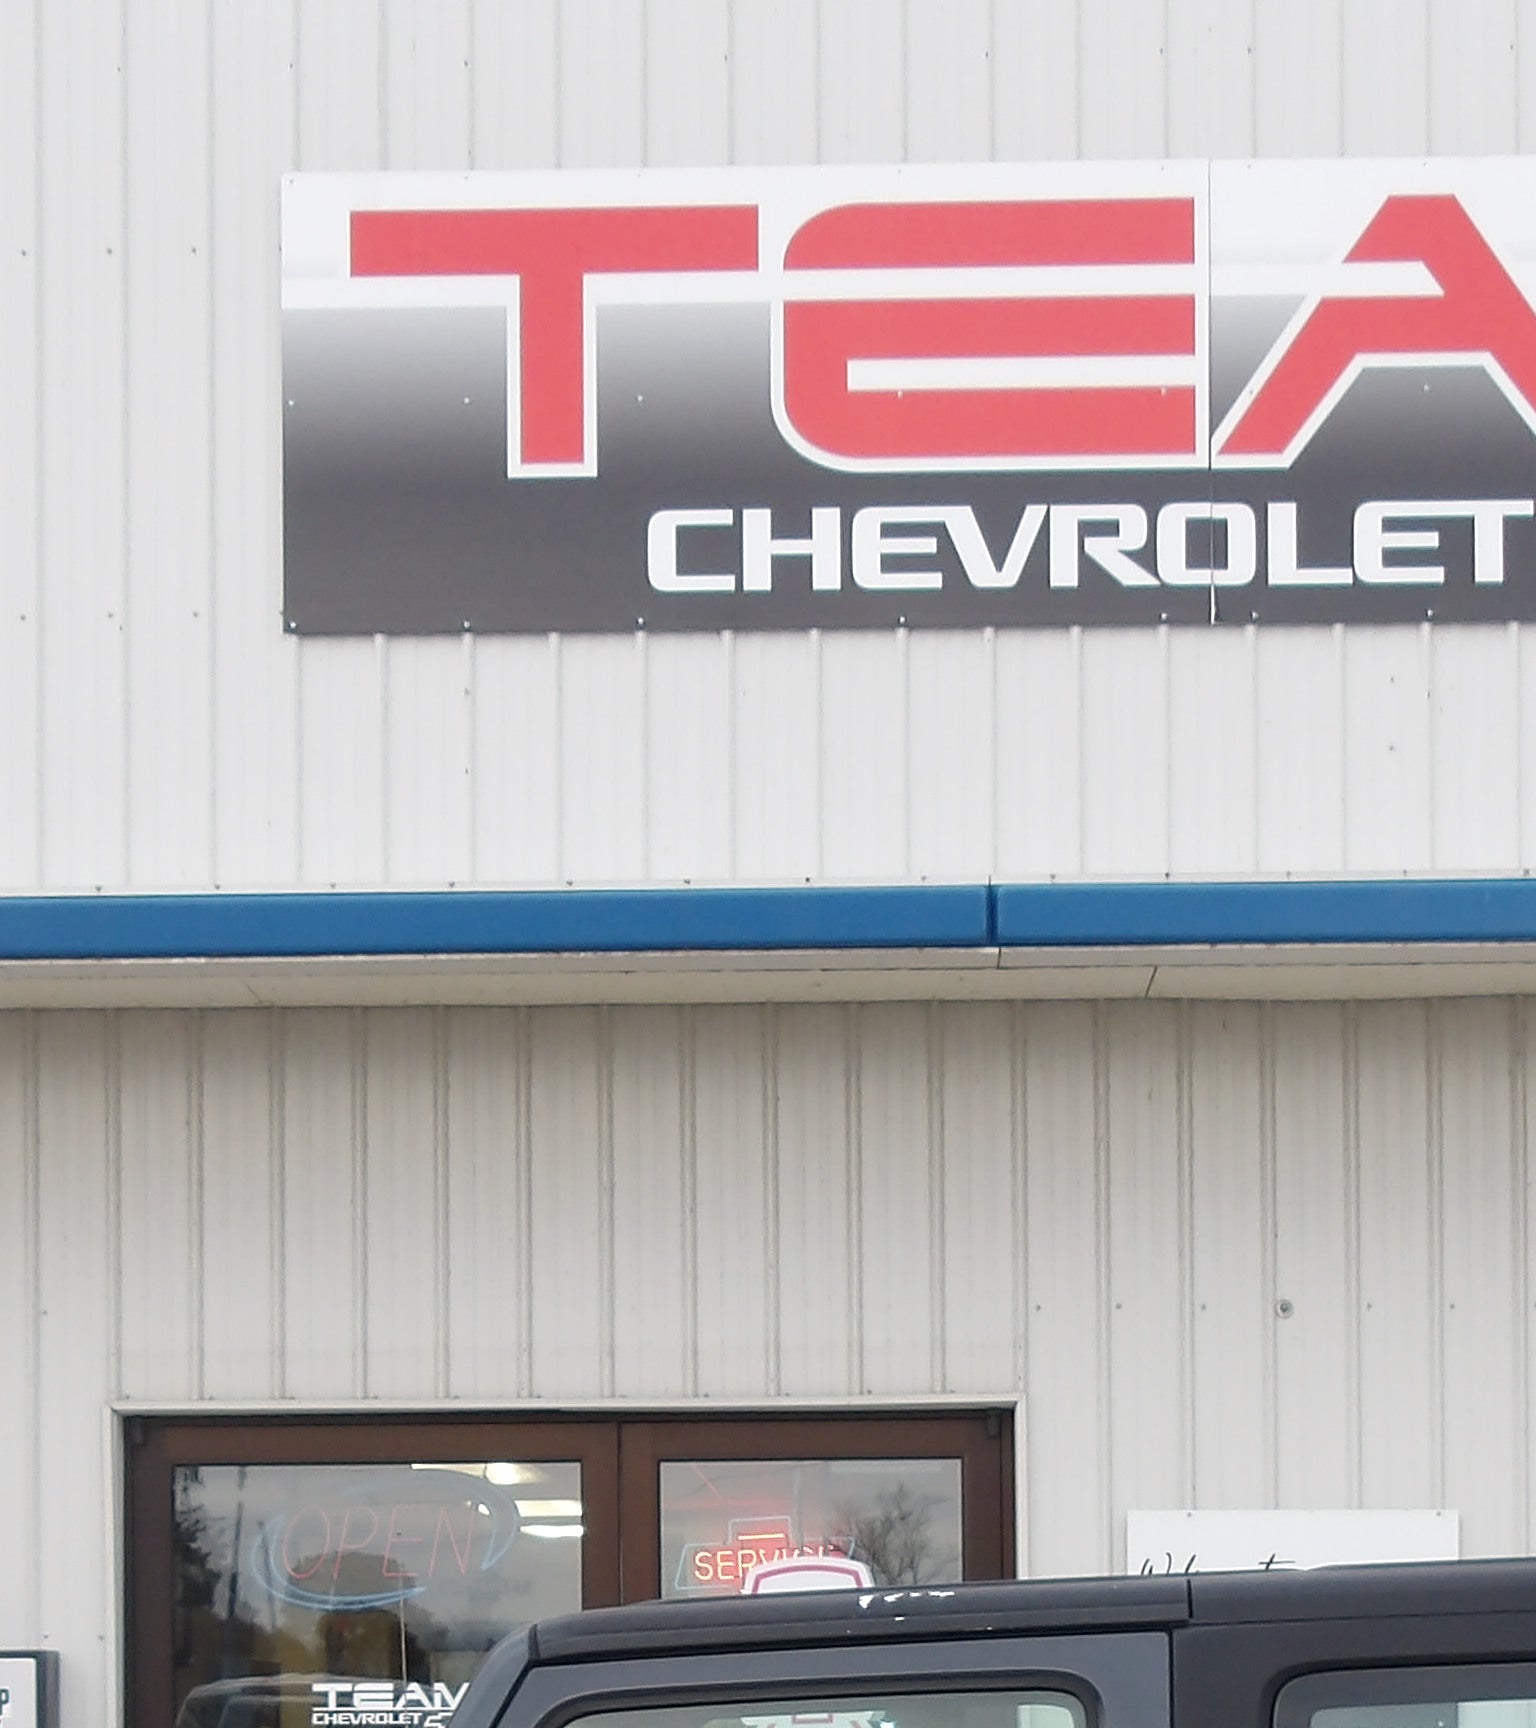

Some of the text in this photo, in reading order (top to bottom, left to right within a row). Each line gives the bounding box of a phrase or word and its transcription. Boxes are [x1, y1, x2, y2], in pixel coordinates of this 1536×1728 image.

[645, 499, 1536, 594] CHEVROLET
[282, 1504, 478, 1581] OPEN
[311, 1712, 422, 1725] CHEVROLET
